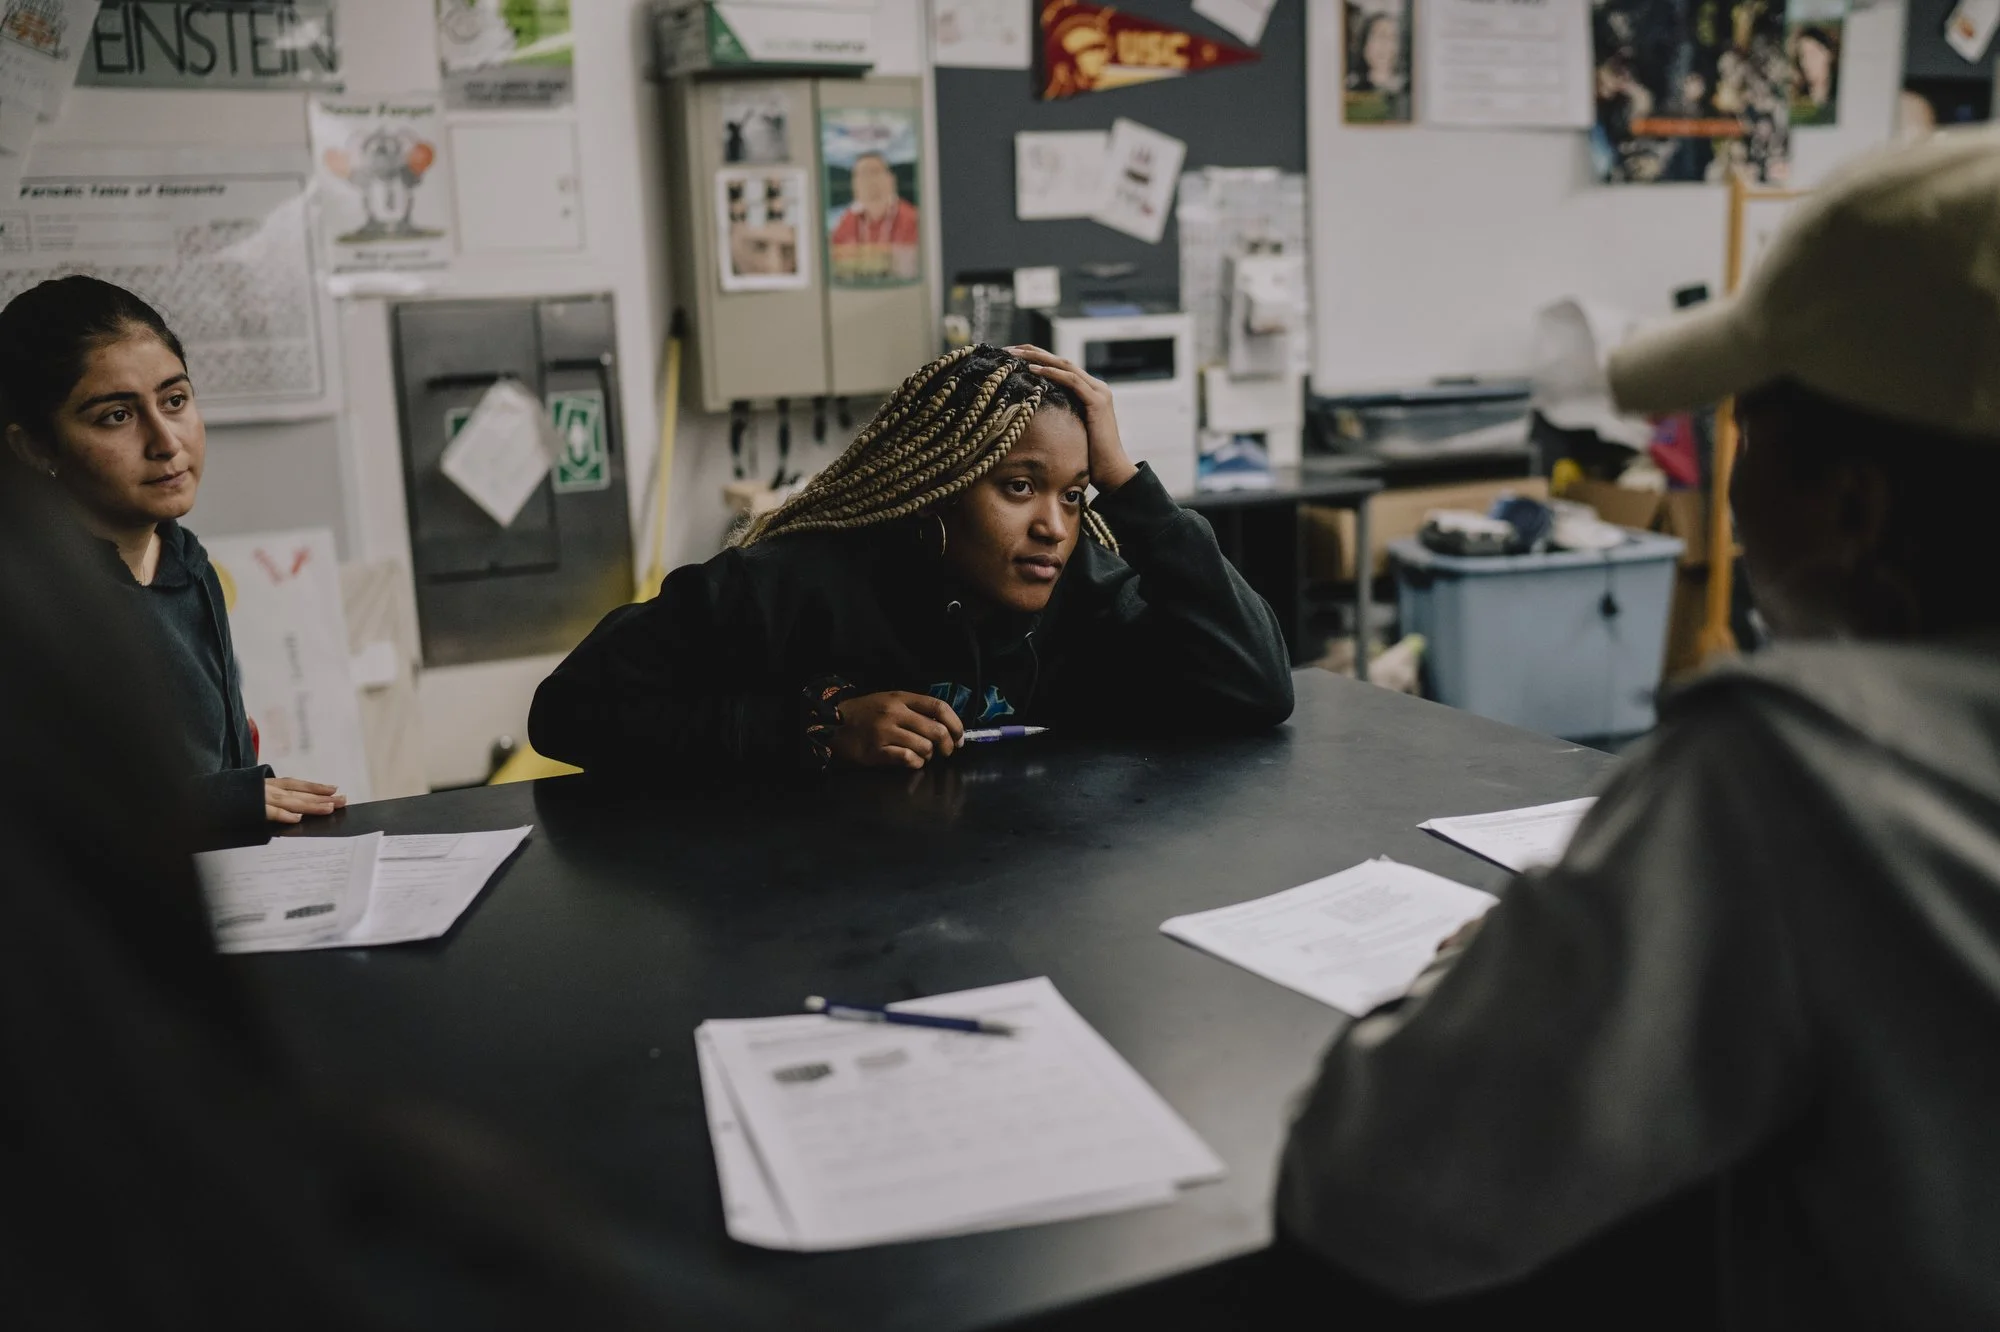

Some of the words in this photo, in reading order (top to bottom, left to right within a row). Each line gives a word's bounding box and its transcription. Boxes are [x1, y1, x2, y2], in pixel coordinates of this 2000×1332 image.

[94, 0, 338, 76] EINSTEIN
[1116, 31, 1190, 69] USC
[19, 184, 83, 199] Periodic
[90, 184, 131, 198] Table
